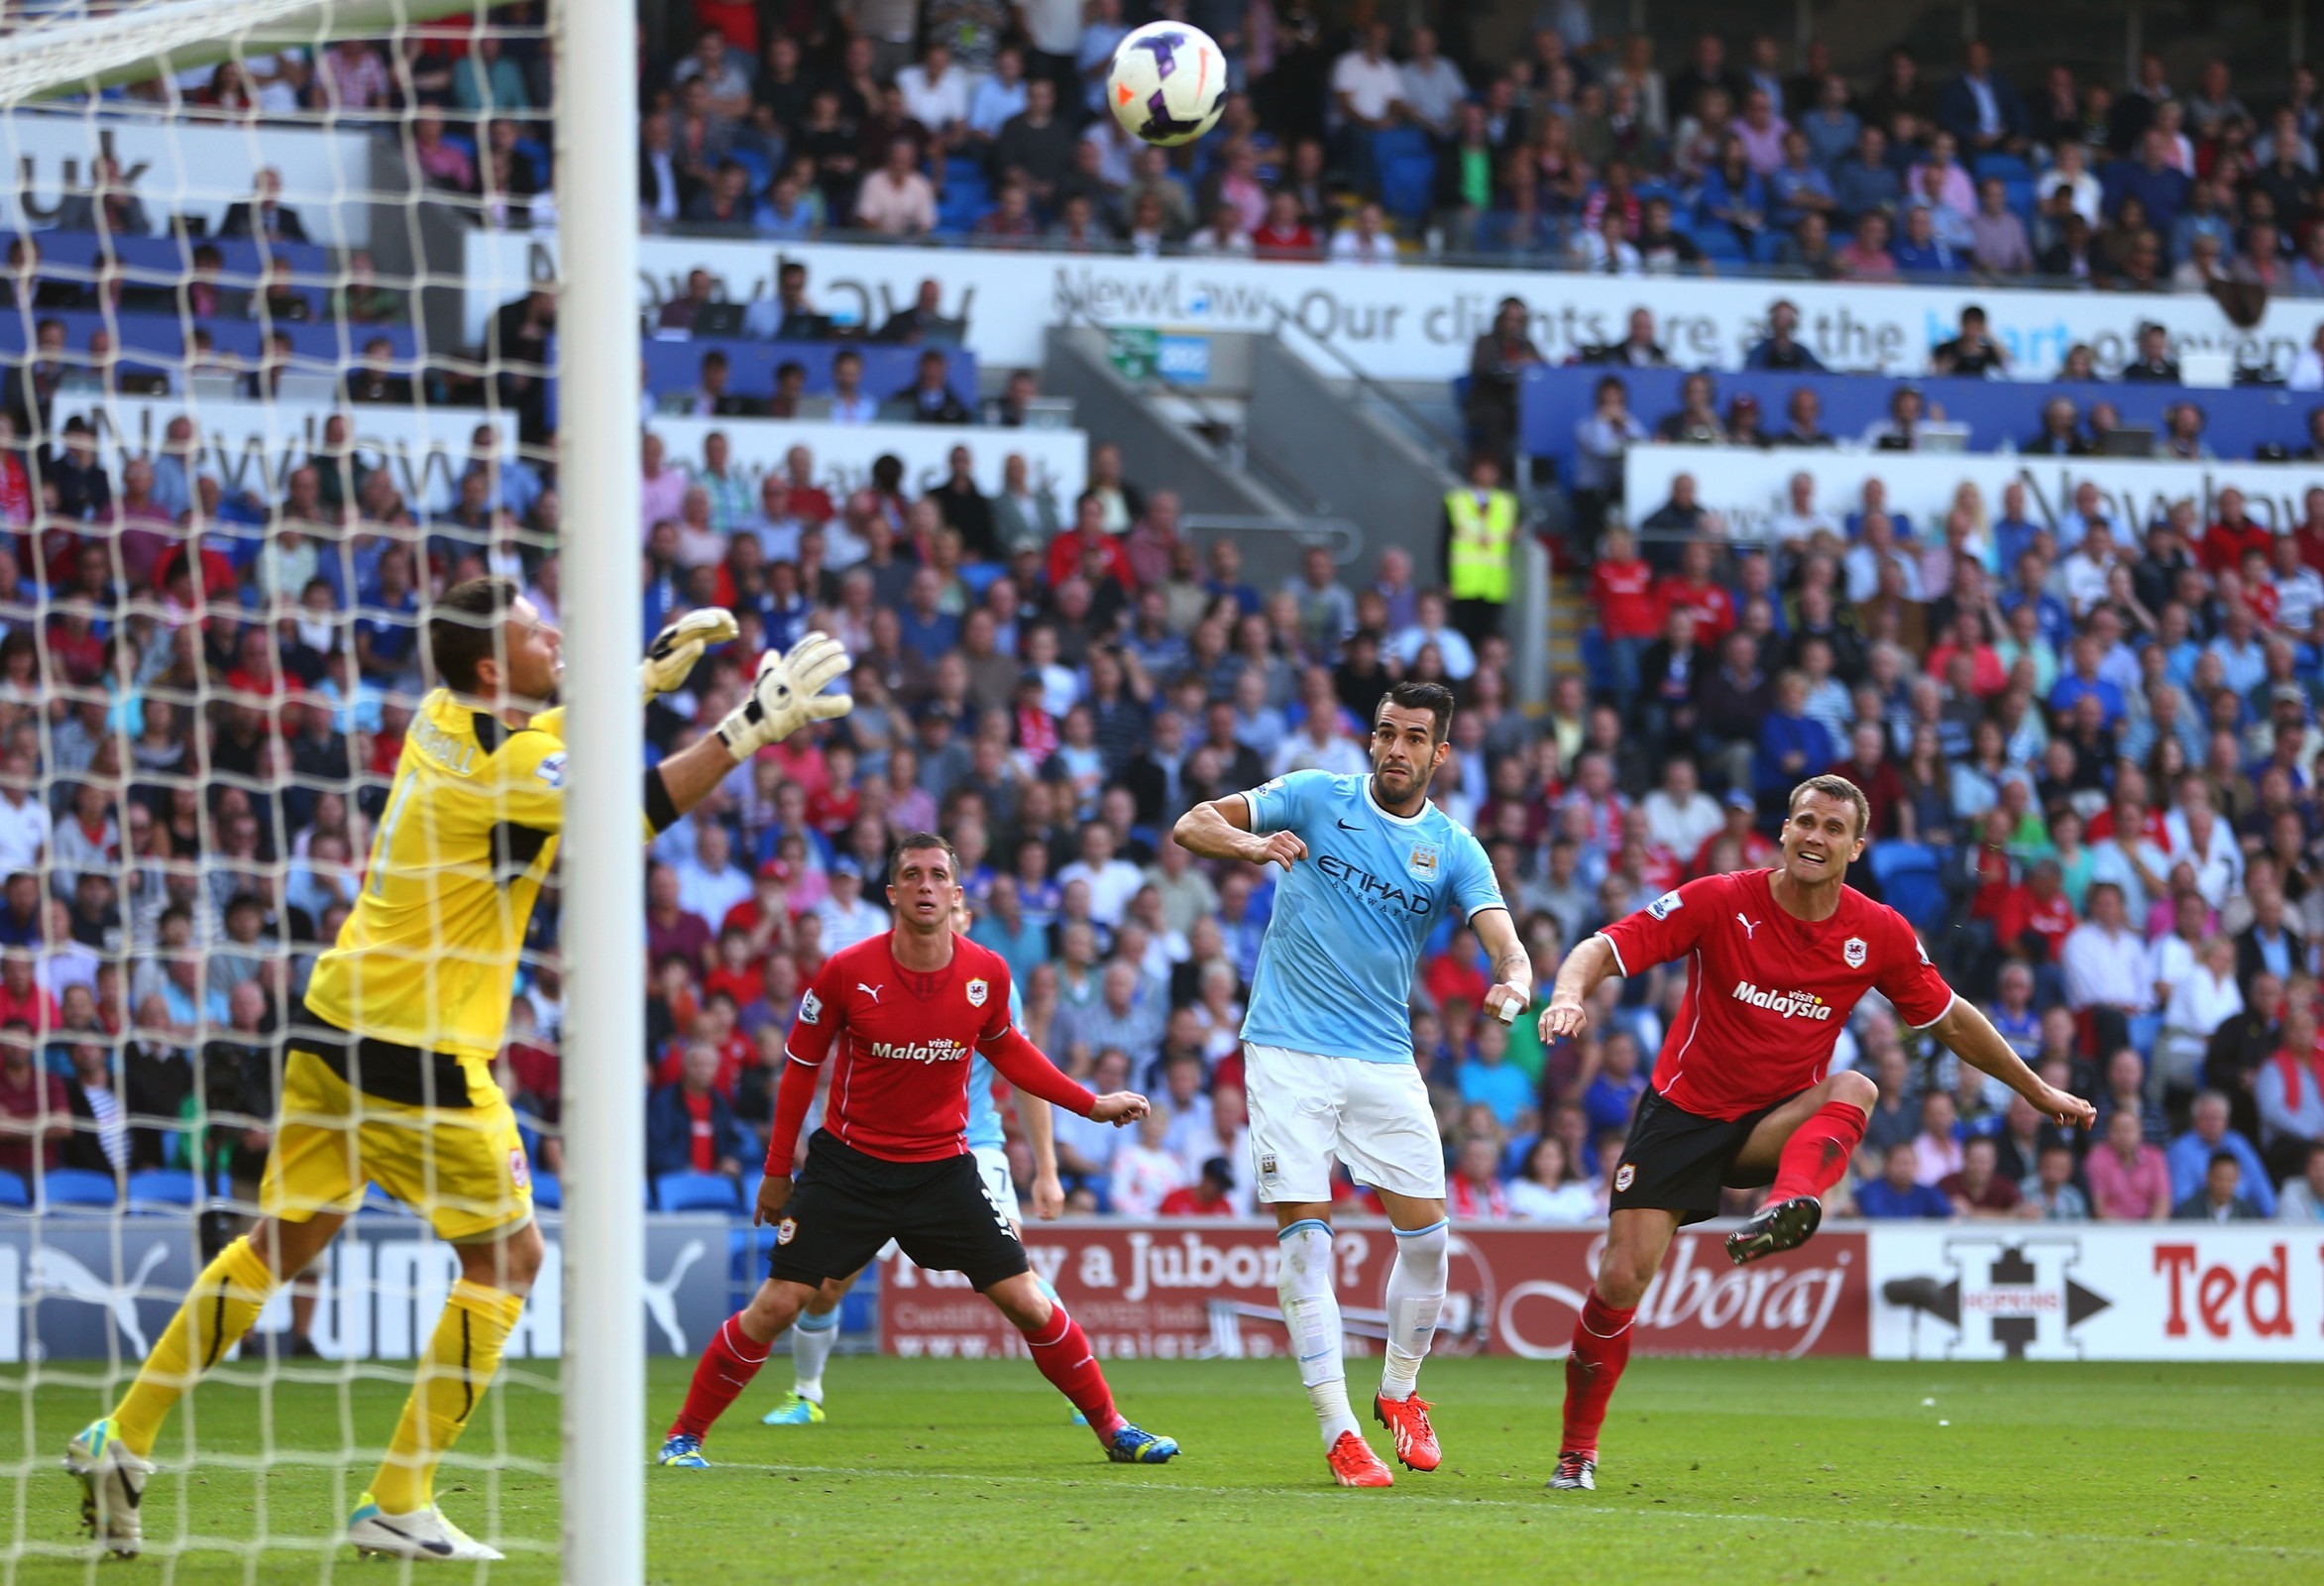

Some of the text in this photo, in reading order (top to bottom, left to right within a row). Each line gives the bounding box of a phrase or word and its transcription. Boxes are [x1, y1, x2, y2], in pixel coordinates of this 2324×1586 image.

[1299, 287, 1402, 344] Our
[1424, 293, 1606, 346] clints
[1817, 303, 1906, 360] the
[1318, 854, 1432, 915] ETIHAD
[1331, 881, 1411, 923] AIRWAYS
[1732, 980, 1831, 1020] Malaysia
[1788, 989, 1816, 1003] visit
[871, 1041, 967, 1065] Malaysia
[928, 1038, 952, 1049] visit
[993, 1167, 1007, 1193] 7
[1963, 1290, 2058, 1312] HOPKINS
[2153, 1243, 2294, 1339] Ted
